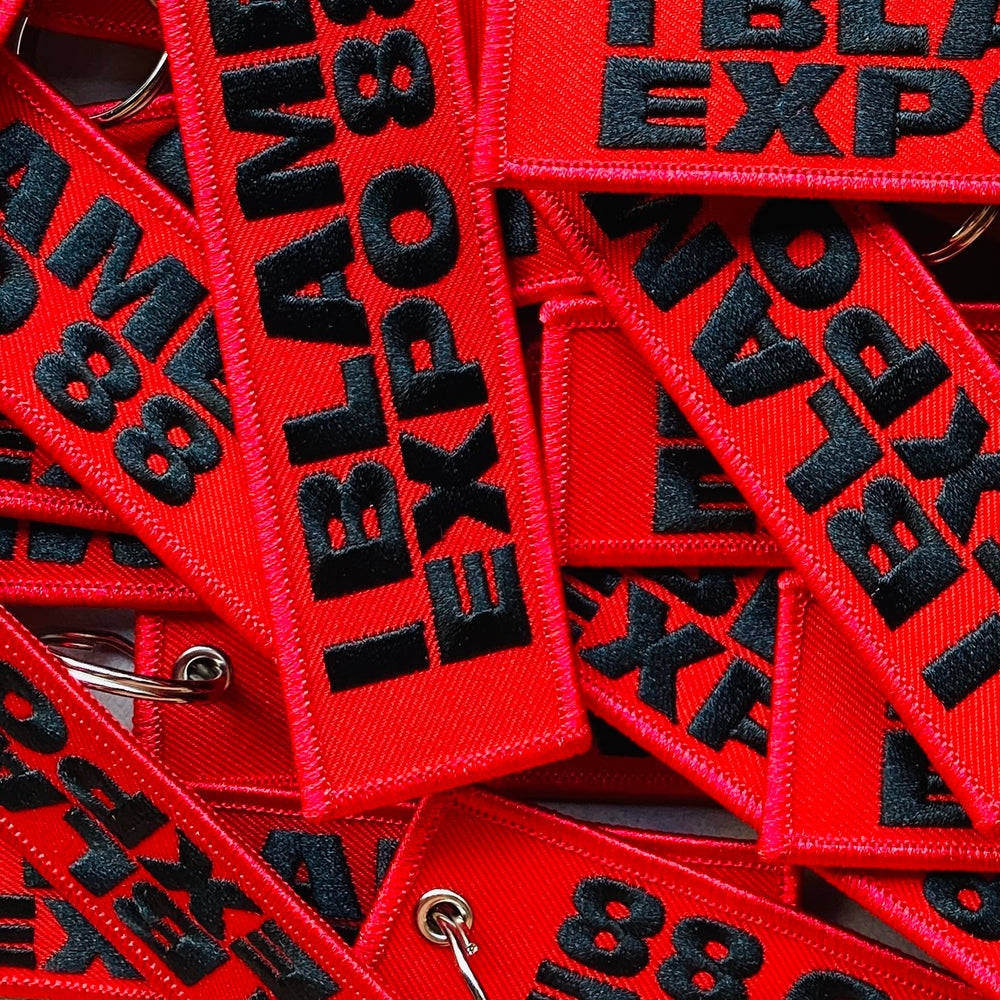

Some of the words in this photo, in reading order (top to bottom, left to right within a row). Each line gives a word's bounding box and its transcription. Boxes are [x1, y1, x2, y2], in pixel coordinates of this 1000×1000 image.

[33, 319, 223, 507] 88
[359, 163, 534, 665] EXPO
[580, 190, 968, 632] BLAM
[323, 619, 431, 693] I
[556, 876, 764, 1000] 88
